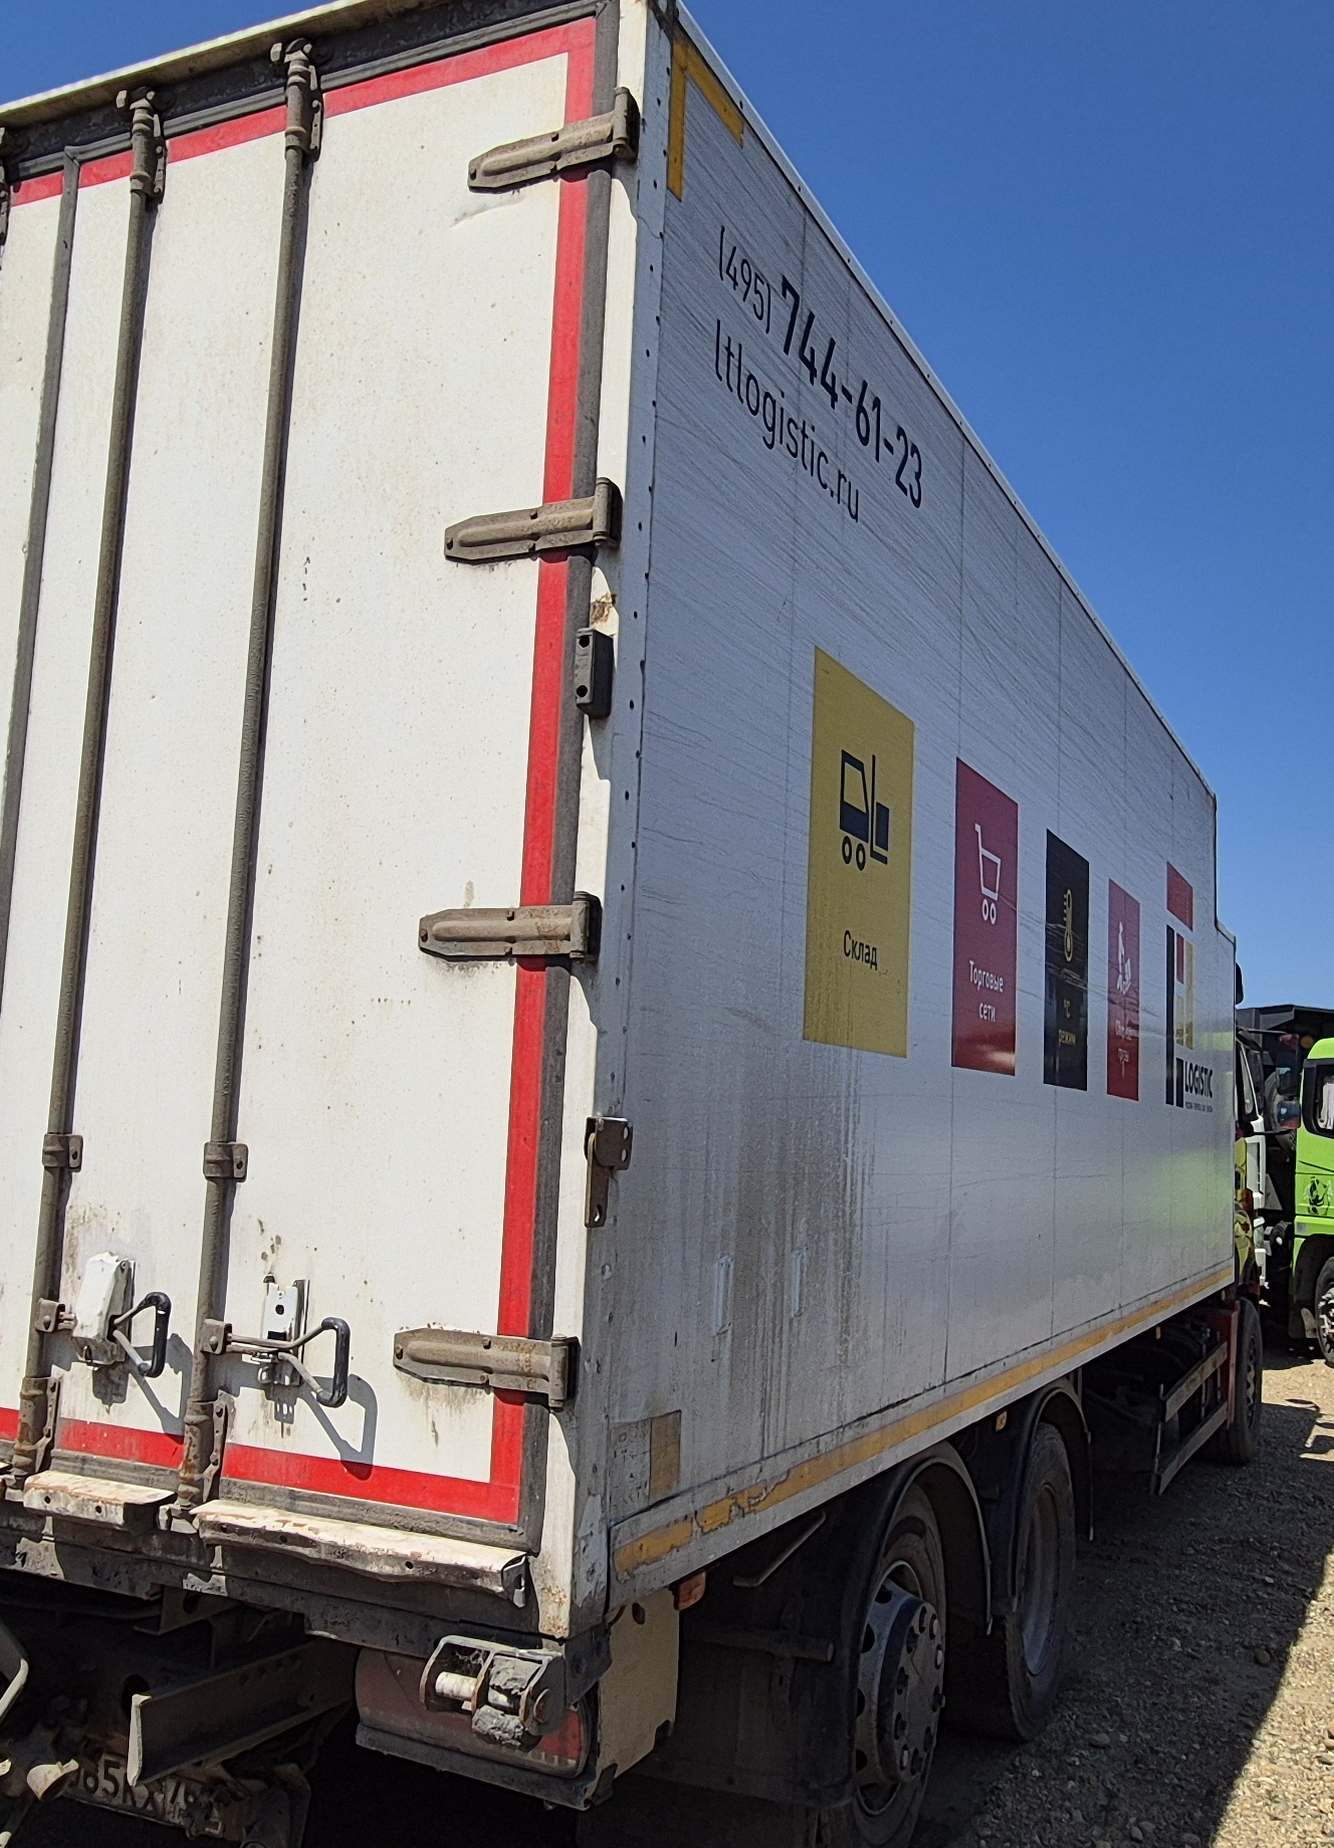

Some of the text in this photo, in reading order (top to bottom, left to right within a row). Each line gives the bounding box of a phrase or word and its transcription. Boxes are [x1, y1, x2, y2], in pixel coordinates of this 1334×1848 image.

[720, 226, 922, 509] (495) 744-61-23
[716, 319, 859, 523] ltlogistic.ru
[843, 929, 878, 971] Склад
[969, 960, 1004, 993] Торговые
[979, 1002, 996, 1022] сети
[1185, 1061, 1213, 1098] LOGISTIC
